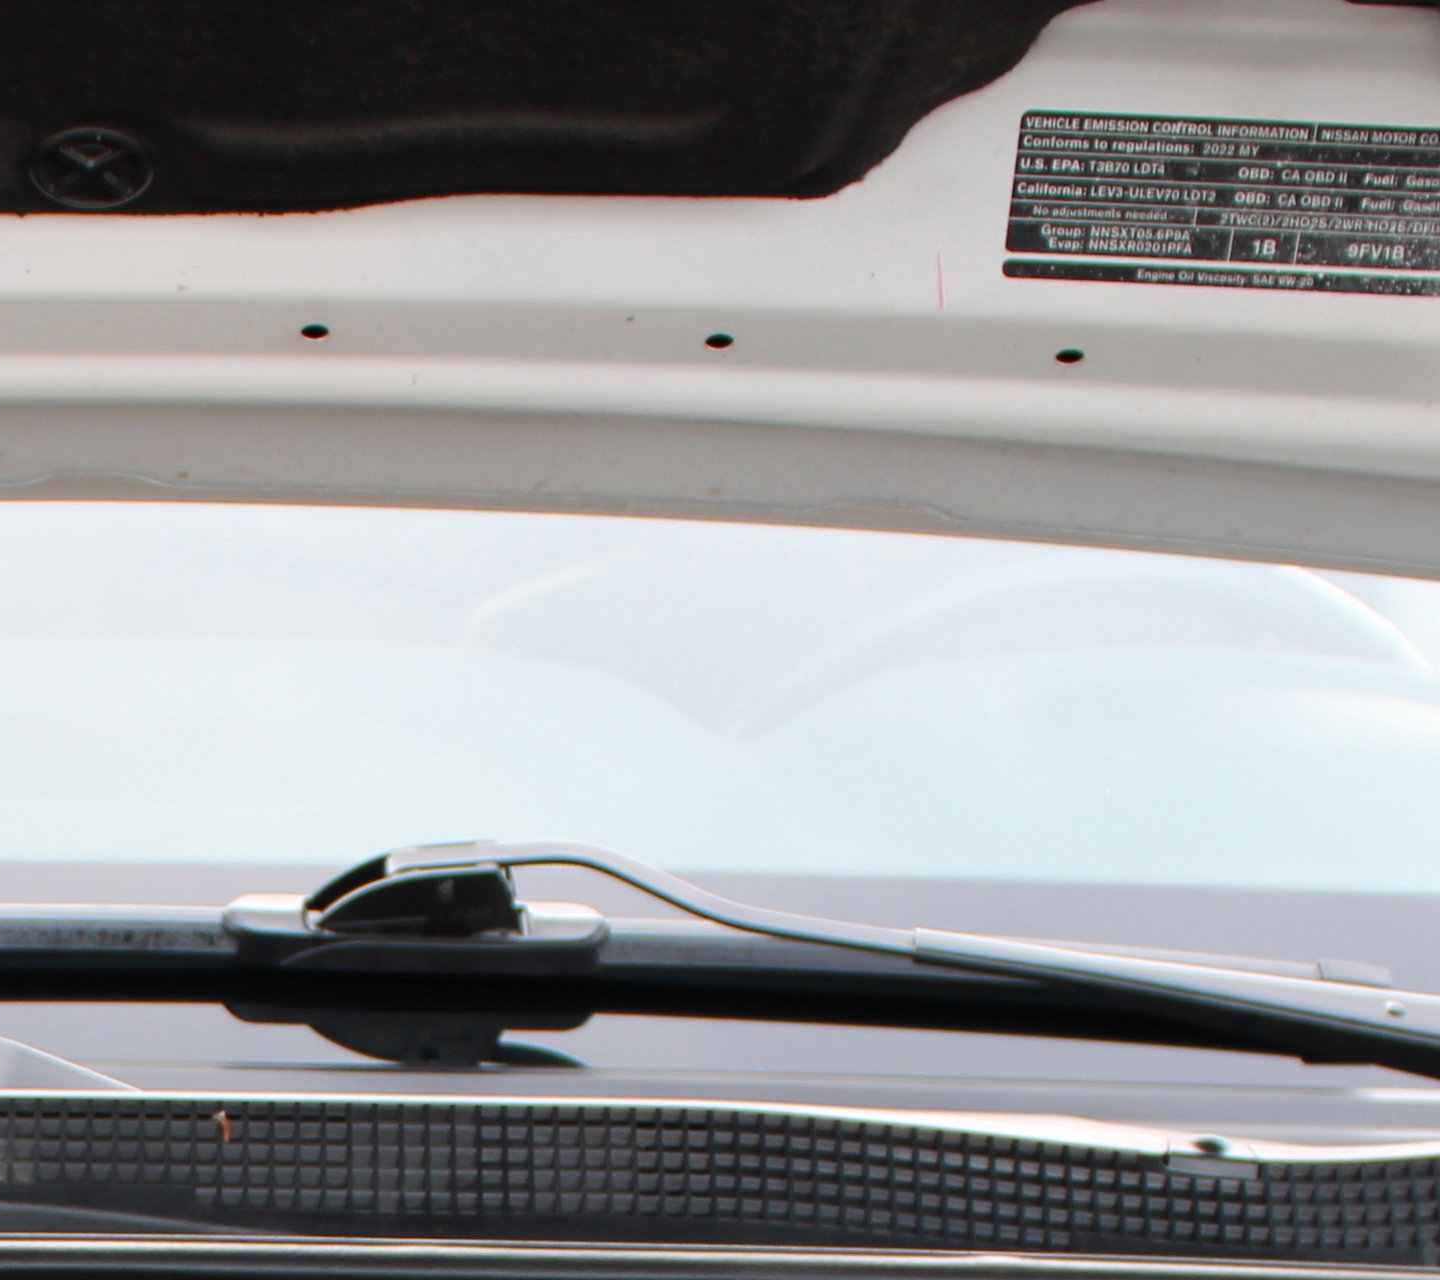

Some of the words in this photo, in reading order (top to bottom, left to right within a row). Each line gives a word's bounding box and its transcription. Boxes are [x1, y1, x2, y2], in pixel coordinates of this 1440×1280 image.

[1025, 116, 1080, 131] VEHICLE
[1083, 118, 1149, 134] EMISSION
[1152, 120, 1214, 137] CONTROL
[1217, 124, 1309, 141] INFORMATION
[1321, 128, 1369, 143] NISSAN
[1372, 130, 1417, 145] MOTOR
[1023, 134, 1090, 149] Conforms
[1094, 136, 1108, 150] to
[1112, 137, 1196, 155] regulations:
[1239, 143, 1260, 156] MY
[1020, 158, 1048, 171] U.S.
[1052, 159, 1085, 172] EPA:
[1089, 160, 1130, 174] T3B70
[1133, 162, 1166, 176] LDT4
[1238, 166, 1274, 181] OBD:
[1281, 167, 1301, 182] CA
[1304, 169, 1335, 183] OBD
[1364, 171, 1399, 187] Fuel:
[1017, 181, 1087, 197] California:
[1090, 185, 1180, 201] LEV3-ULEV70
[1234, 192, 1271, 206] OBD:
[1278, 194, 1297, 207] CA
[1300, 195, 1332, 209] OBD
[1033, 204, 1049, 217] No
[1052, 205, 1122, 220] adjustments
[1125, 208, 1168, 221] needed
[1041, 223, 1086, 240] Group:
[1048, 237, 1084, 253] Evap:
[1252, 238, 1277, 256] 1B
[1347, 243, 1405, 261] 9FV1B
[1137, 268, 1175, 283] Engine
[1178, 270, 1195, 282] Oil
